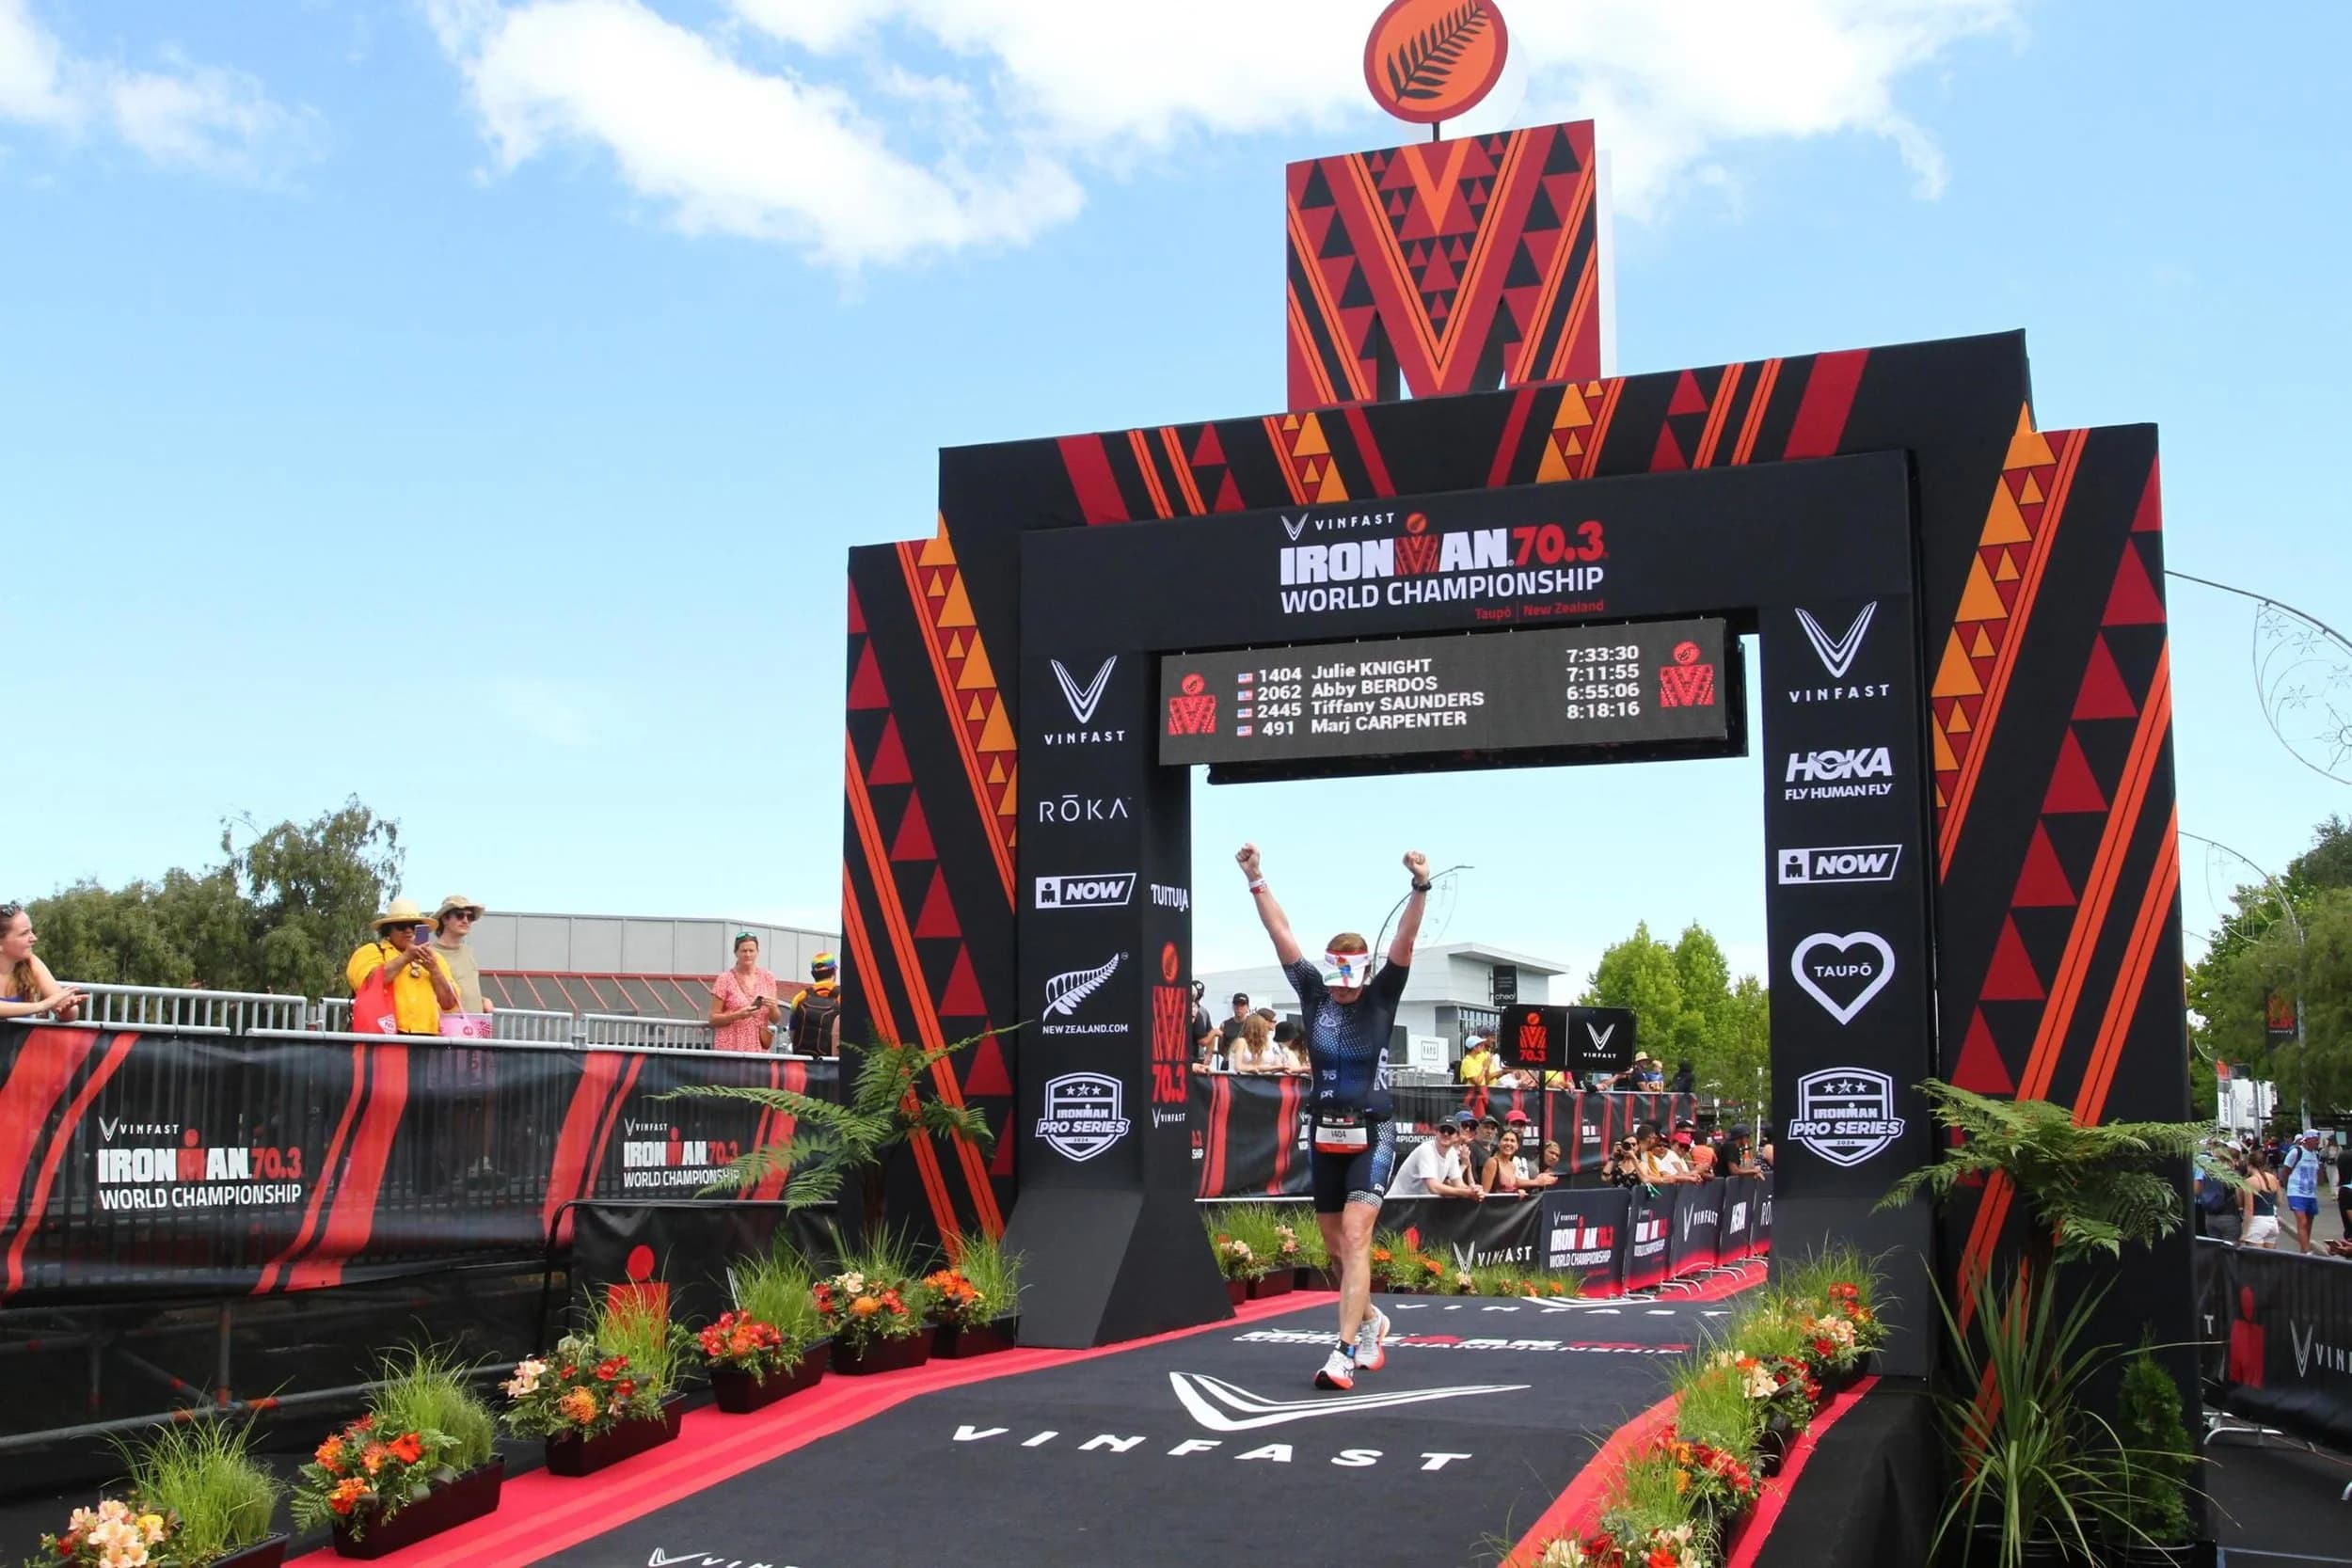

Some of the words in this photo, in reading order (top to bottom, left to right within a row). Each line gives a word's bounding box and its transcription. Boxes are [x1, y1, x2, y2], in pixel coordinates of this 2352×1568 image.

[1315, 513, 1394, 531] VINFAST
[1280, 526, 1508, 585] IRONMAN
[1513, 520, 1605, 566] 70.3
[1280, 587, 1378, 613] WORLD
[1387, 567, 1604, 606] CHAMPIONSHIP
[1523, 604, 1551, 617] New
[1555, 600, 1604, 614] Zealand
[1259, 667, 1302, 683] 1404
[1311, 662, 1355, 680] Julie
[1360, 658, 1432, 676] KNIGHT
[1566, 645, 1639, 663] 7:33:30
[1258, 685, 1302, 701] 2062
[1311, 682, 1356, 700] Abby
[1361, 676, 1438, 694] BERDOS
[1566, 664, 1639, 682] 7:11:55
[1258, 703, 1301, 719] 2445
[1311, 699, 1375, 716] Tiffany
[1380, 692, 1485, 711] SAUNDERS
[1566, 683, 1640, 700] 6:55:06
[1789, 684, 1890, 703] VINFAST
[1262, 721, 1294, 736] 491
[1311, 717, 1350, 734] Marj
[1356, 711, 1467, 730] CARPENTER
[1566, 702, 1640, 719] 8:18:16
[1044, 731, 1125, 745] VINFAST
[1786, 747, 1893, 782] HOKA
[1785, 788, 1808, 800] FLY
[1811, 785, 1867, 800] HUMAN
[1868, 784, 1893, 796] FLY
[1816, 853, 1888, 875] NOW
[1065, 880, 1125, 900] NOW
[1814, 962, 1872, 977] TAUPŌ
[1520, 1050, 1546, 1062] 70.3
[1152, 1064, 1187, 1103] 70.3
[1057, 1107, 1108, 1119] IRONMAN
[1160, 1113, 1185, 1123] VINFAST
[1814, 1107, 1878, 1119] IRONMAN
[119, 1124, 180, 1134] VINFAST
[636, 1123, 668, 1132] VINFAST
[1040, 1120, 1070, 1134] PRO
[1072, 1119, 1127, 1133] SERIES
[1791, 1121, 1831, 1135] PRO
[1834, 1120, 1900, 1134] SERIES
[624, 1140, 707, 1167] IRONMAN
[98, 1147, 249, 1183] IRONMAN
[251, 1147, 301, 1180] 70.3
[624, 1171, 661, 1187] WORLD
[100, 1188, 167, 1210] WORLD
[172, 1184, 301, 1207] CHAMPIONSHIP
[1693, 1210, 1719, 1227] VINFAST
[1549, 1253, 1570, 1268] WORLD
[1571, 1250, 1612, 1266] CHAMPIONSHIP
[952, 1424, 1472, 1471] VINFAST
